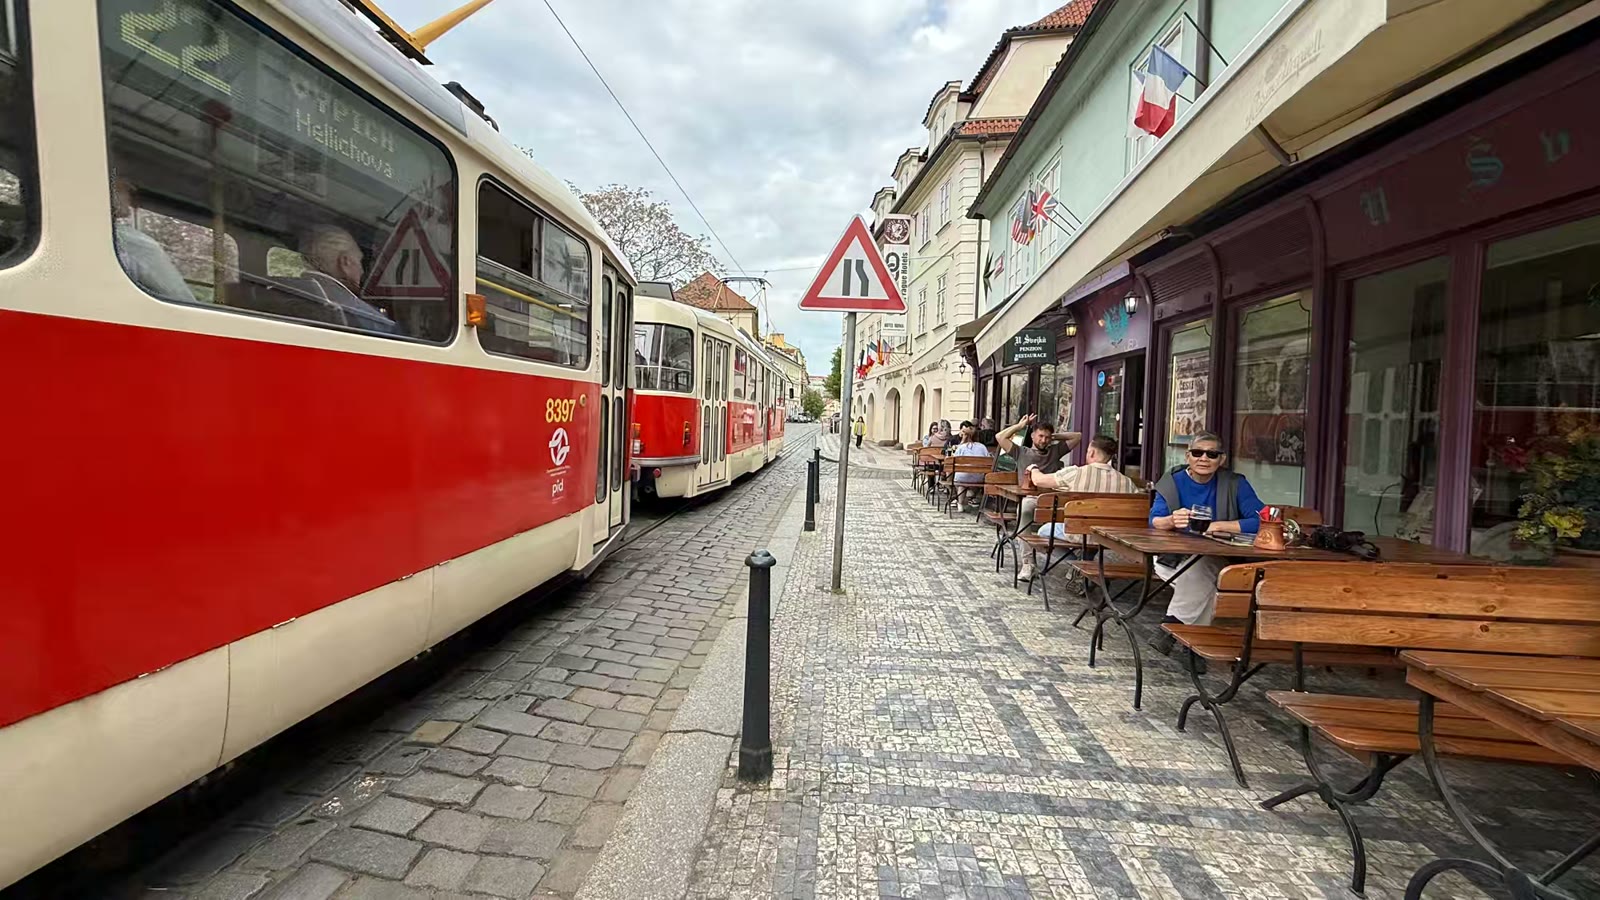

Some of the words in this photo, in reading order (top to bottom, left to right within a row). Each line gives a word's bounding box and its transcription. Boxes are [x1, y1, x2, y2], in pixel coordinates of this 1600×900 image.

[120, 1, 232, 95] 22
[296, 108, 394, 179] Hellichova
[545, 398, 576, 423] 8397
[552, 479, 564, 497] pid
